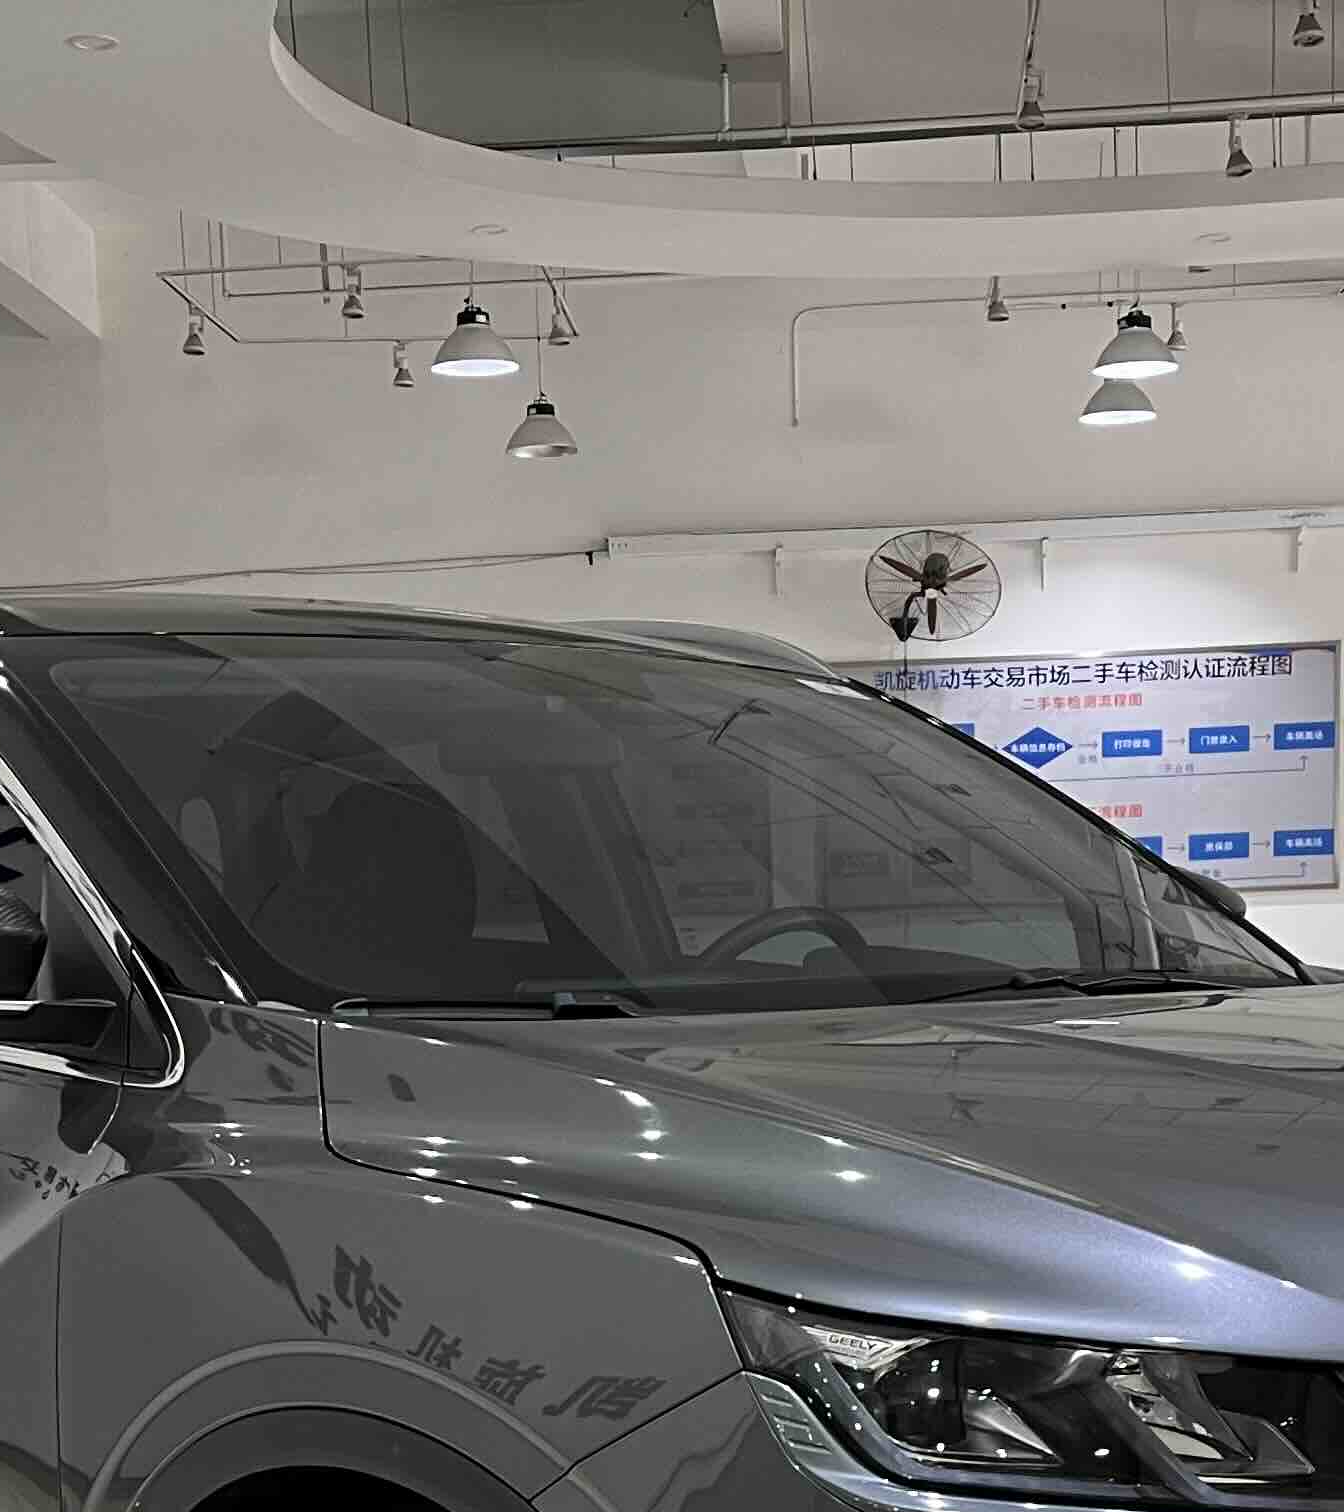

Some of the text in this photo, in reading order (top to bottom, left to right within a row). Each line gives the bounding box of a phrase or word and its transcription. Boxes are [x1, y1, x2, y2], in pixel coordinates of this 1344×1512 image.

[874, 653, 1293, 691] 凯旋机动车交易市场二手车检测认证流程图
